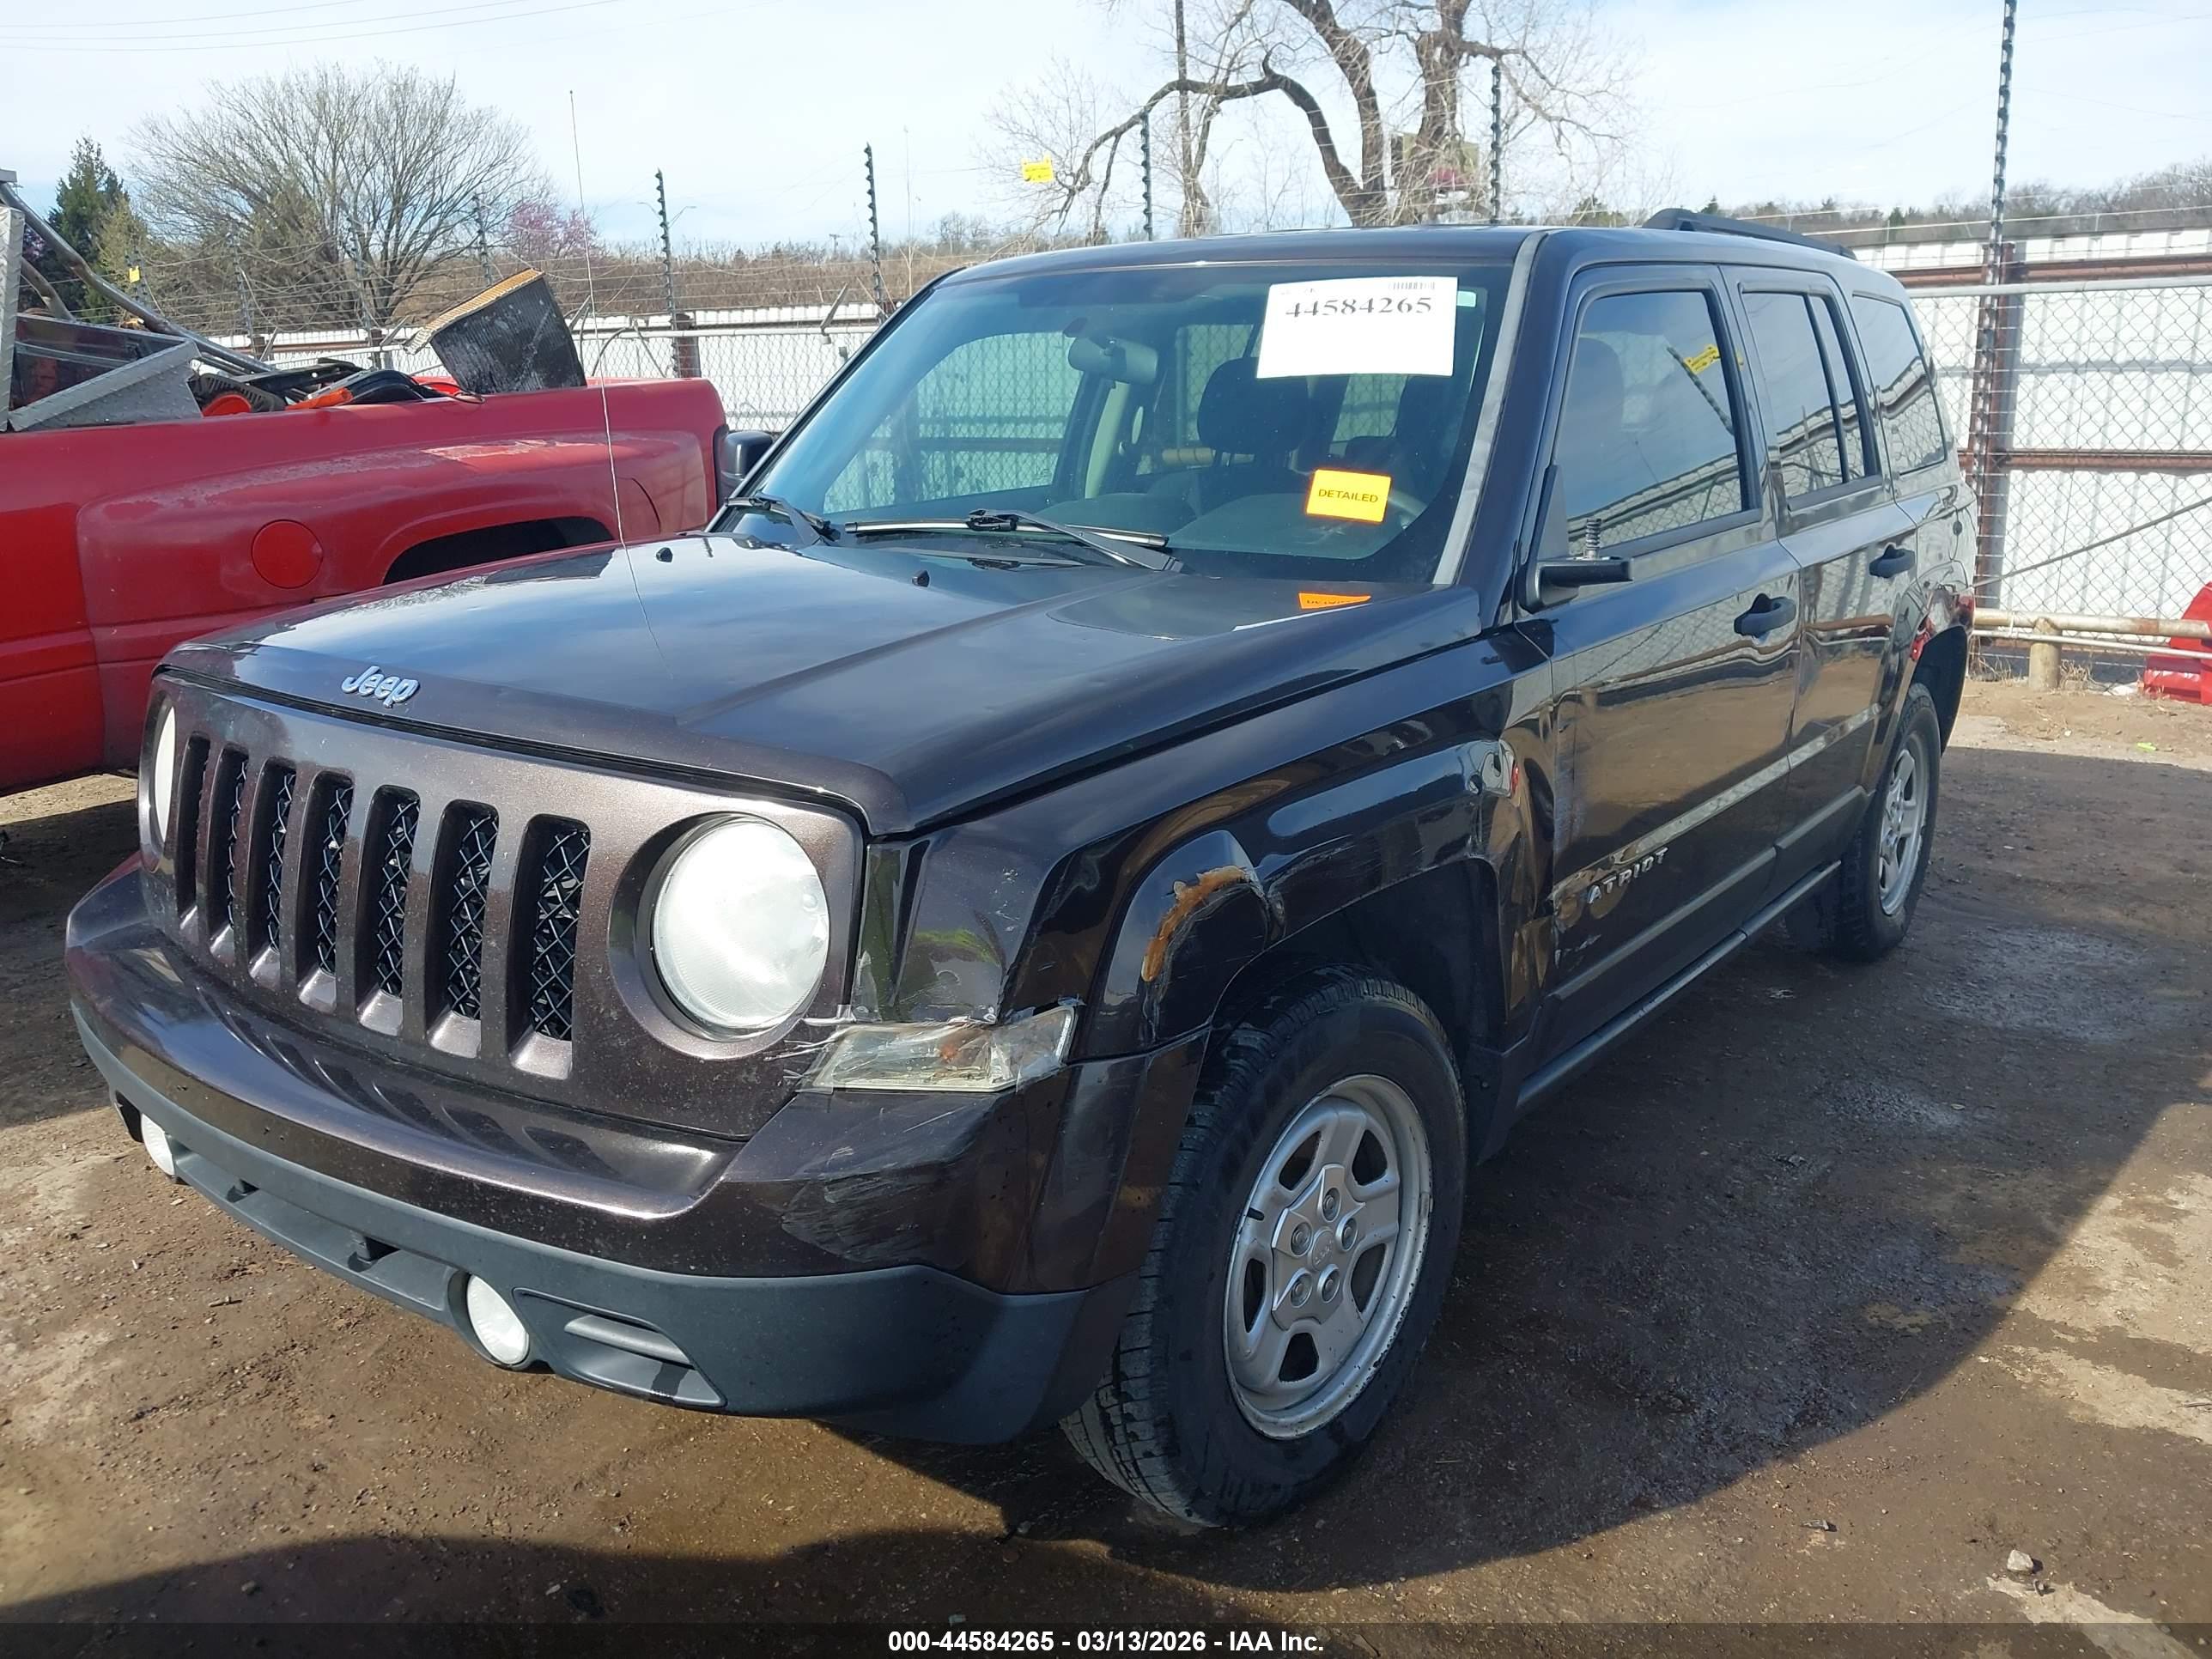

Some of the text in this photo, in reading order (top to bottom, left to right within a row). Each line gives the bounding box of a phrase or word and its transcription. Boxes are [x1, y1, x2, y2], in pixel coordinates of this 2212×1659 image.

[1285, 296, 1432, 318] 44584265
[1318, 489, 1379, 503] DETAILED
[341, 665, 420, 708] Jeep
